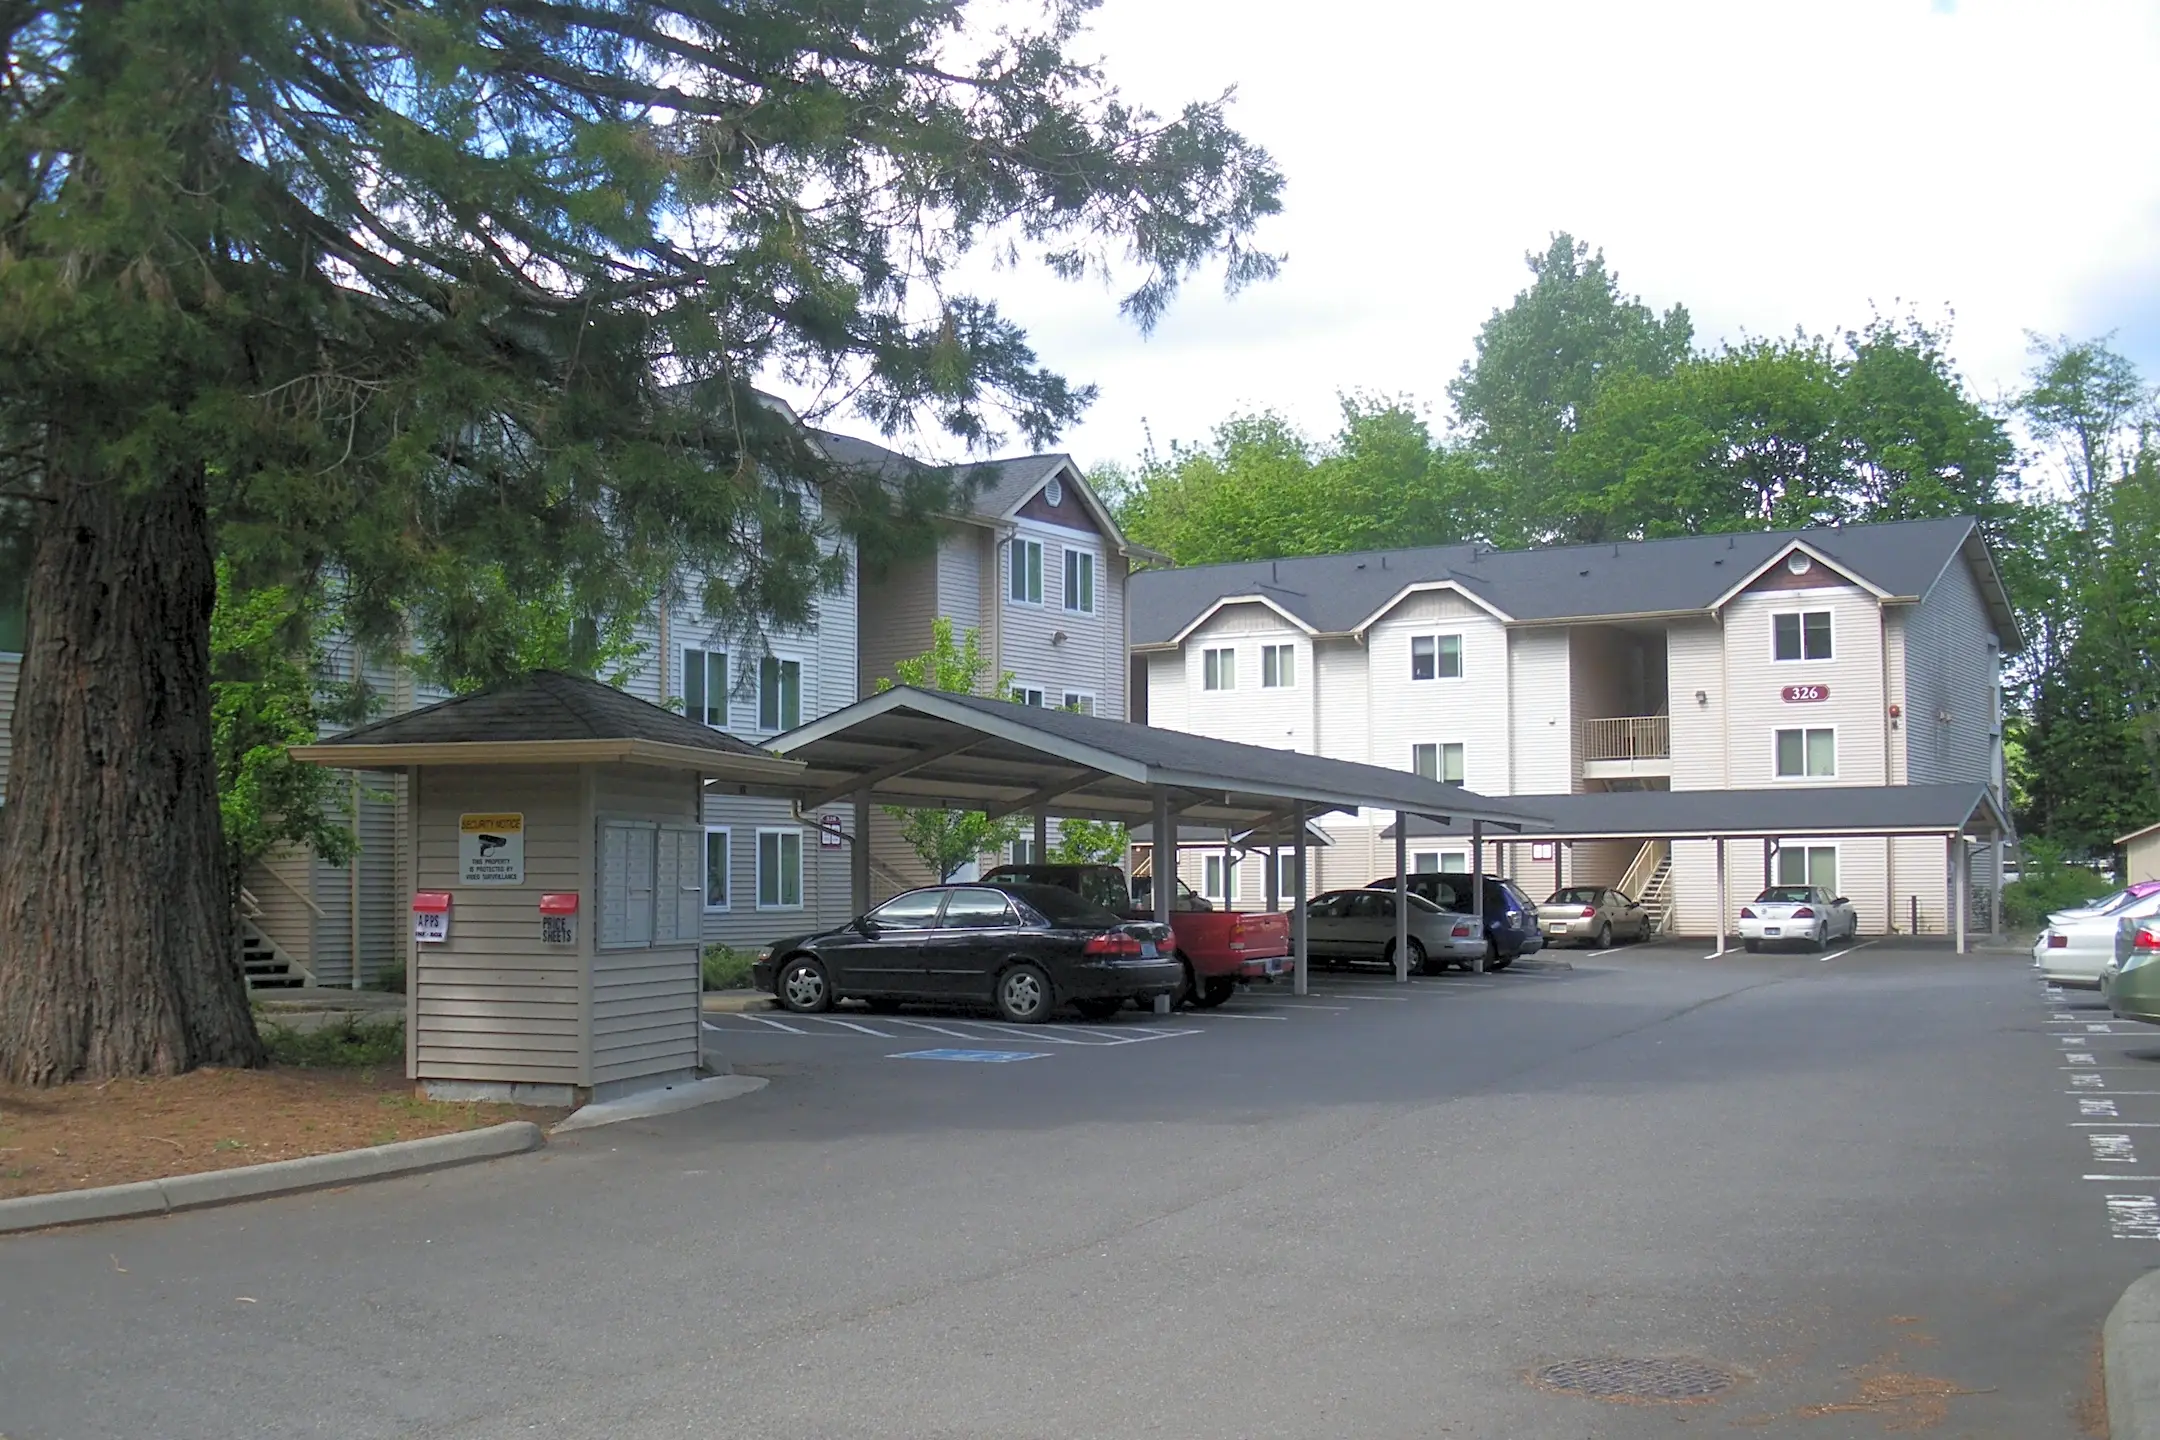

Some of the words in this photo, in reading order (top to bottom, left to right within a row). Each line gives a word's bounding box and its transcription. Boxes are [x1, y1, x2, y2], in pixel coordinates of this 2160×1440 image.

[1791, 686, 1818, 700] 326
[461, 820, 493, 830] SECURITY
[496, 819, 521, 829] NOTICE
[418, 914, 439, 928] APPS
[543, 917, 566, 930] PRICE
[543, 929, 571, 943] SHEETS
